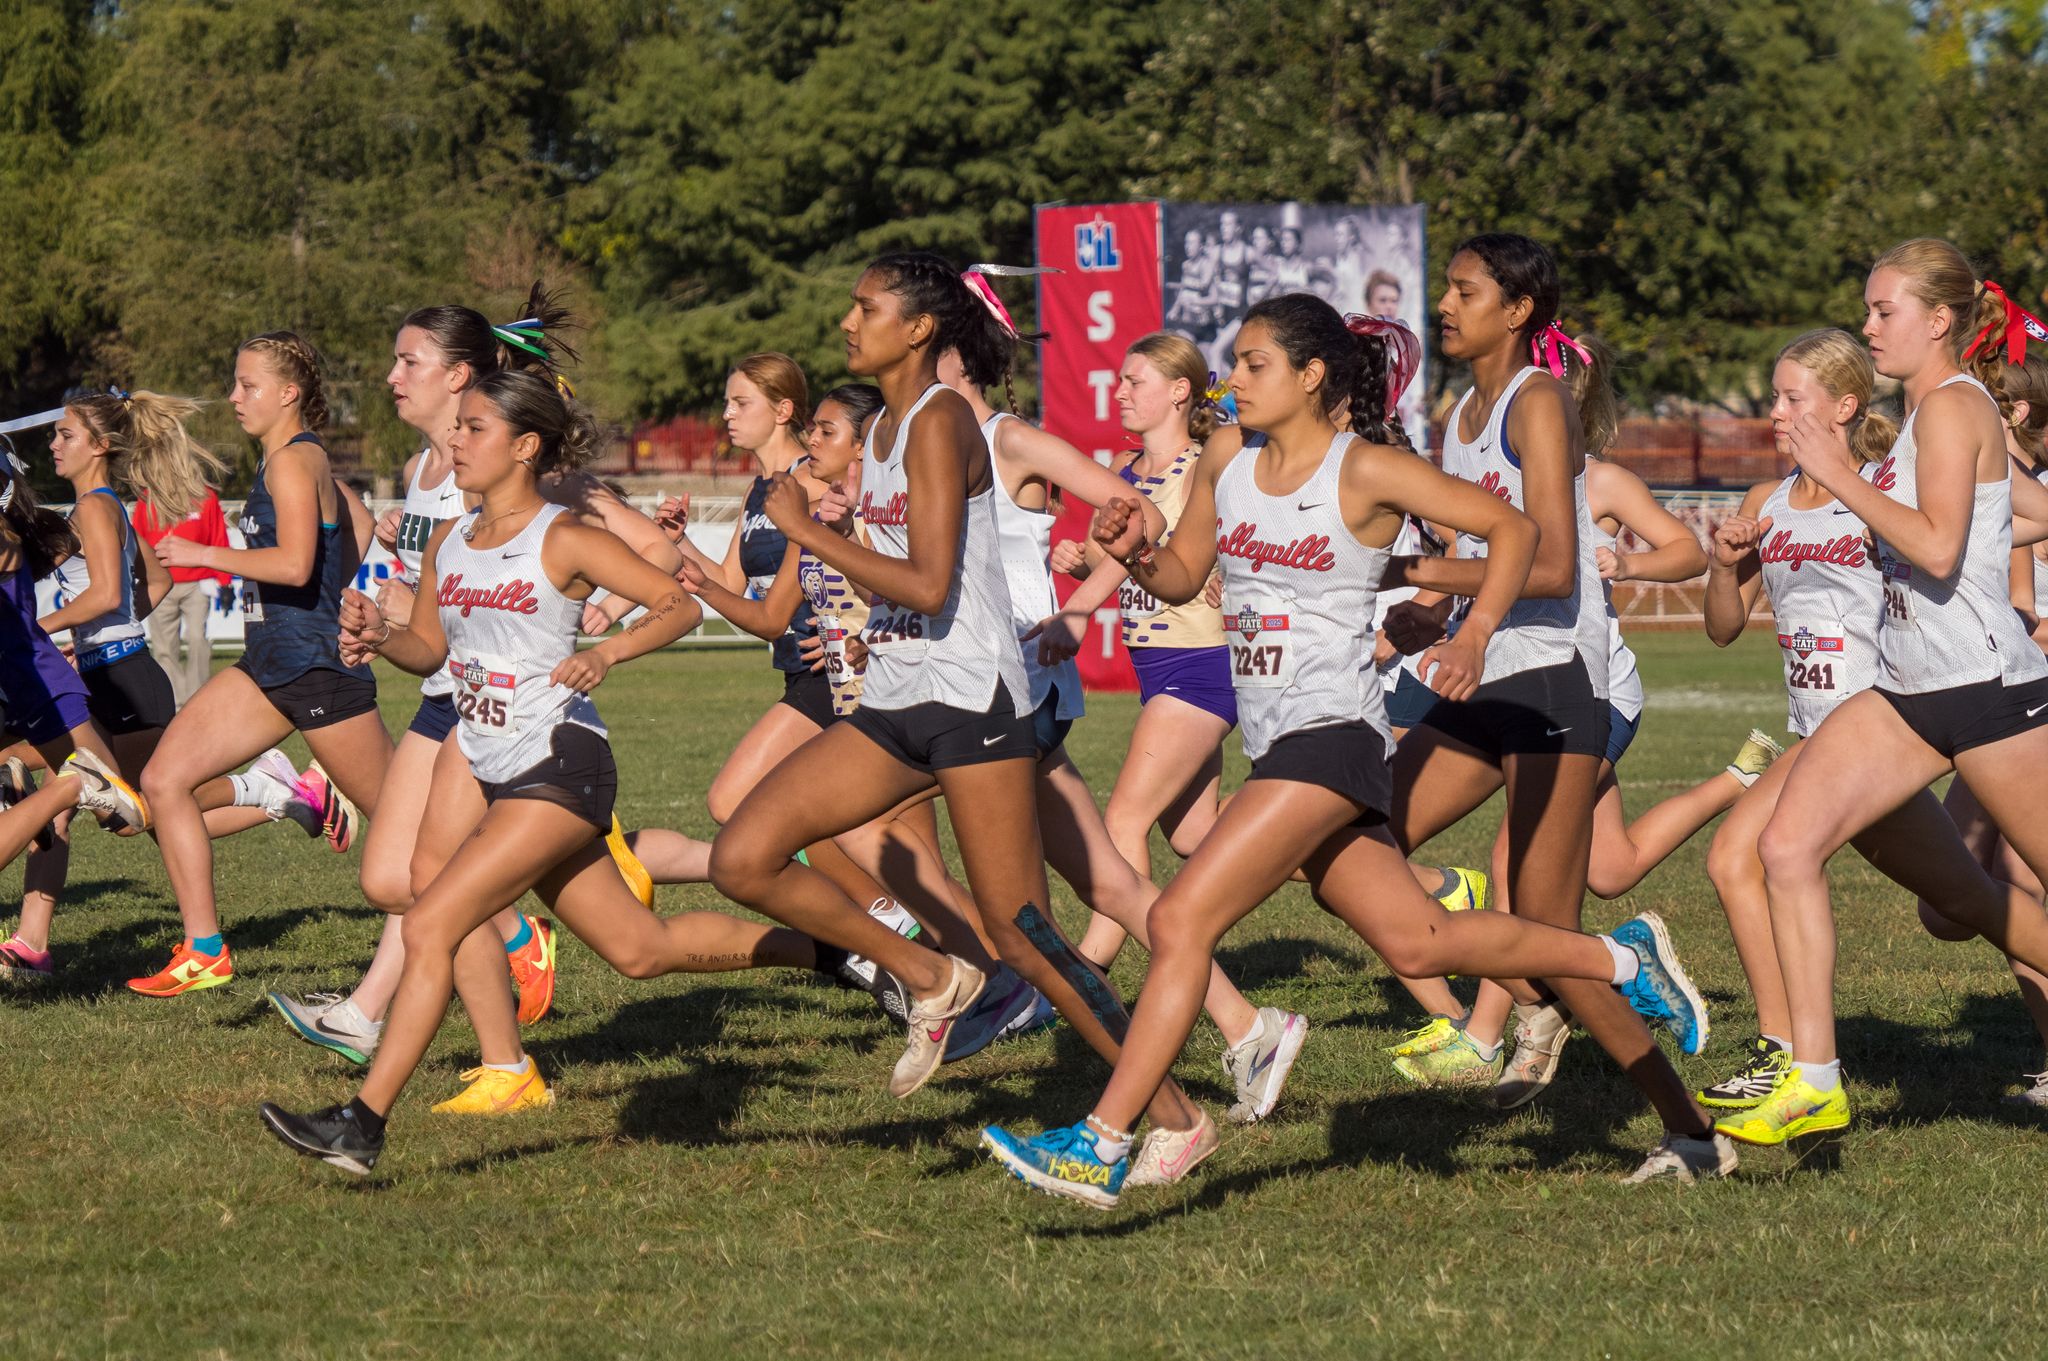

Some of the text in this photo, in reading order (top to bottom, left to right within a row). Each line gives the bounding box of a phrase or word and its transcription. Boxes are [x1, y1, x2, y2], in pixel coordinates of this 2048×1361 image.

[1119, 587, 1156, 612] 2340
[866, 611, 923, 645] 2246
[1237, 618, 1262, 629] STATE
[81, 644, 120, 668] NIKE
[1791, 638, 1818, 649] STATE
[1233, 645, 1283, 676] 2247
[463, 668, 489, 684] STATE
[1789, 660, 1835, 690] 2241
[457, 689, 507, 728] 2245
[1049, 1157, 1110, 1187] HOKA
